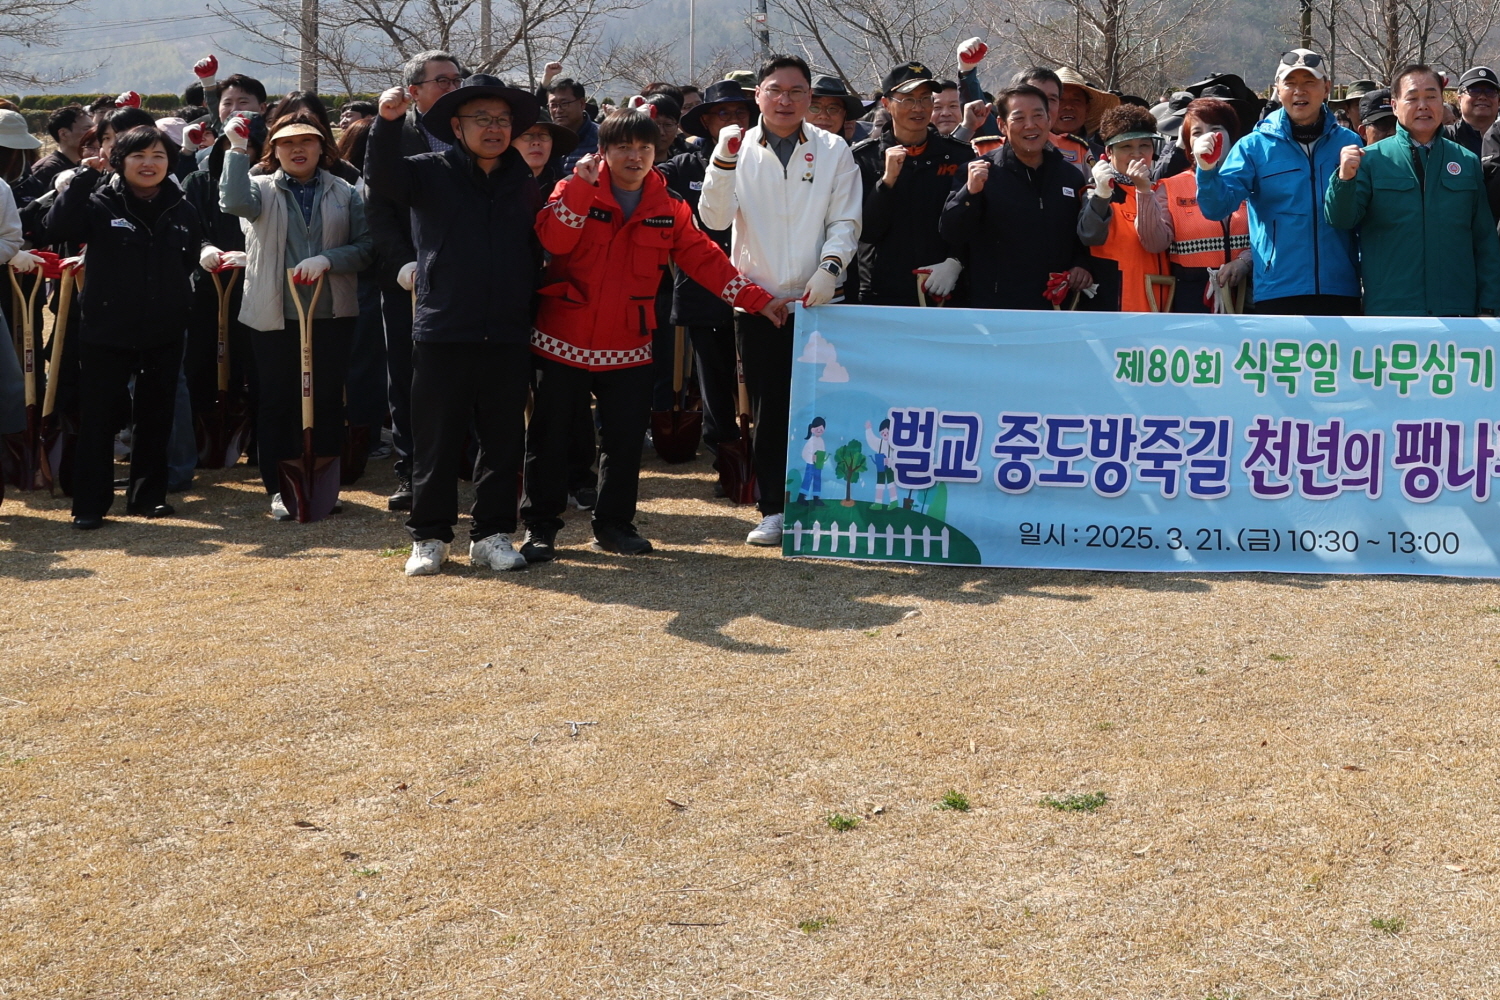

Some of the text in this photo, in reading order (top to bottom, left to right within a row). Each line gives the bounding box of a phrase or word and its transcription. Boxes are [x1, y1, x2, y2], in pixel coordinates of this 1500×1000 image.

[1114, 347, 1222, 386] 제80회
[1233, 339, 1339, 395] 식목일
[1350, 341, 1494, 396] 나무심기
[889, 408, 981, 485] 벌교
[993, 414, 1231, 495] 중도방죽길
[1244, 417, 1381, 497] 천년의
[1019, 522, 1065, 547] 일시
[1085, 524, 1160, 550] 2025.
[1166, 527, 1189, 550] 3.
[1196, 528, 1231, 551] 21.
[1237, 528, 1281, 552] (금)
[1287, 530, 1359, 553] 10:30
[1387, 531, 1460, 555] 13:00
